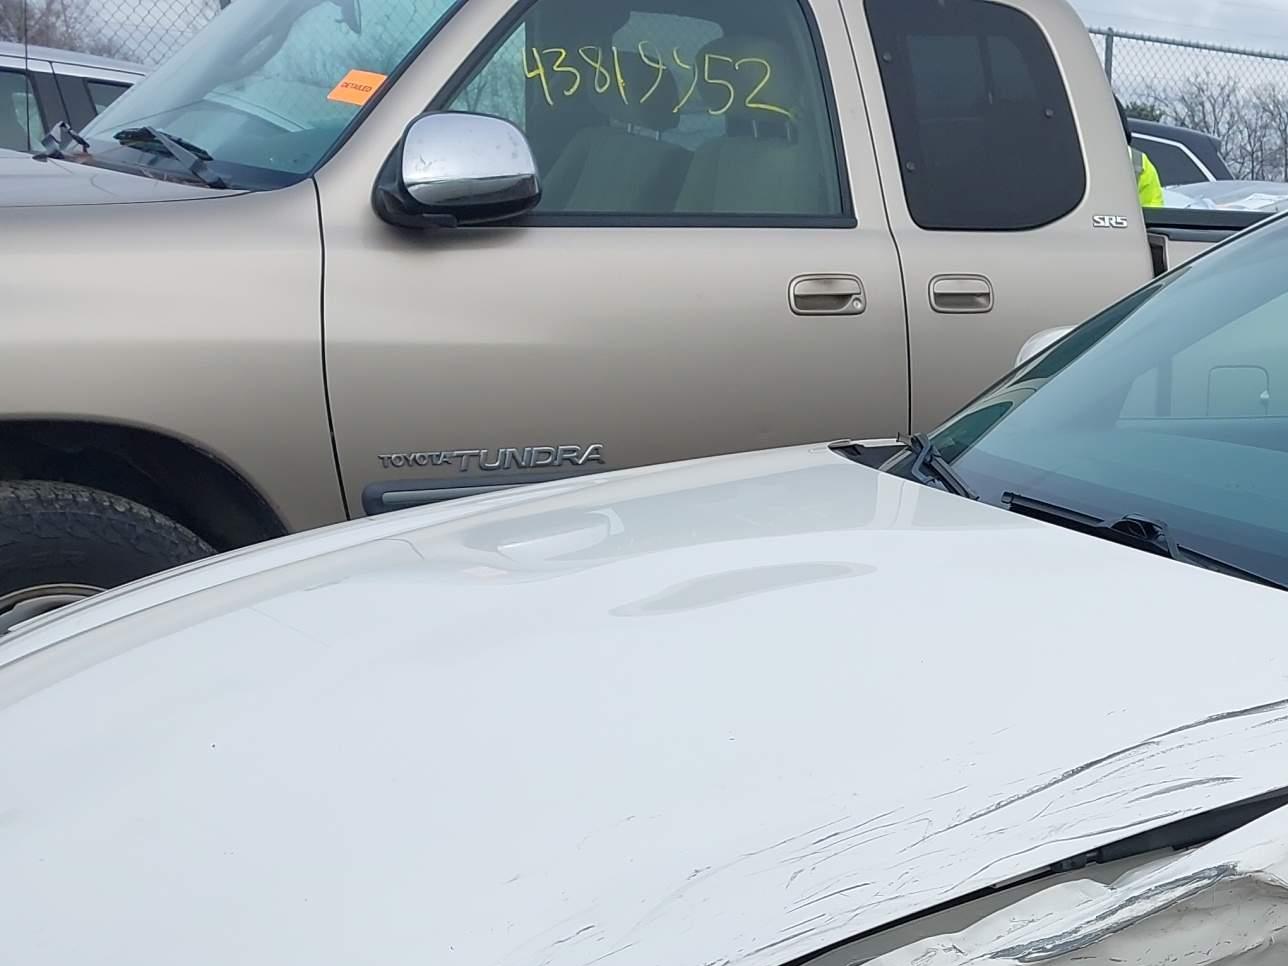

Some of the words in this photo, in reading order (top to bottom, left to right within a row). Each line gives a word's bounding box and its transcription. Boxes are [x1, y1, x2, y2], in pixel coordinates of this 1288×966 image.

[1092, 215, 1128, 229] SR5
[378, 452, 451, 469] TOYOTA
[453, 444, 605, 472] TUNDRA
